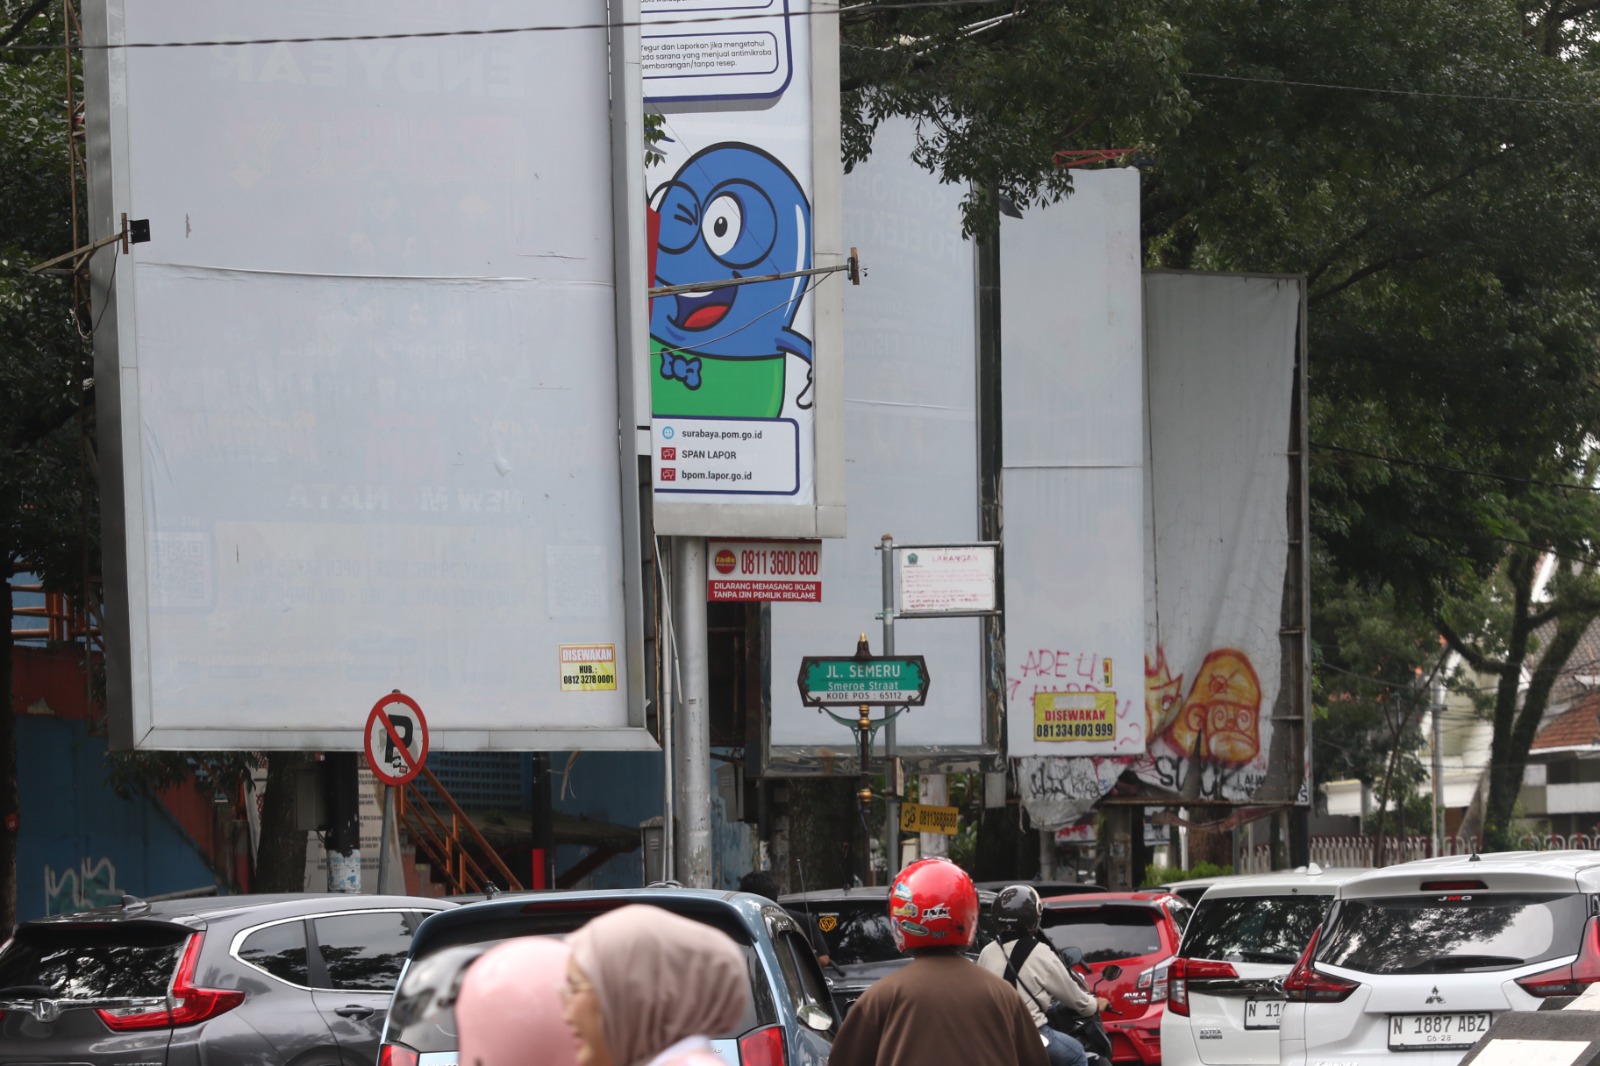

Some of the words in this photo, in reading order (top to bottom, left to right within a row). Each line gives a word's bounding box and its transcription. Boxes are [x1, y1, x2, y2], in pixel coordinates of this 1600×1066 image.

[676, 42, 710, 51] Laporkan
[710, 41, 723, 50] jika
[723, 40, 765, 49] mengetahui
[682, 52, 700, 60] yang
[701, 50, 730, 60] menjual
[730, 49, 772, 57] antimikroba
[715, 60, 737, 68] resep.
[681, 429, 763, 441] surabaya.pom.go.id
[681, 450, 706, 459] SPAN
[707, 451, 737, 460] LAPOR
[681, 470, 753, 481] bpom.lapor.go.id
[741, 550, 767, 575] 0811
[770, 551, 797, 575] 3600
[798, 551, 819, 575] 800
[714, 582, 751, 590] DILARANG
[752, 583, 793, 591] MEMASANG
[713, 591, 737, 599] TANPA
[753, 591, 782, 599] PEMILIK
[782, 592, 816, 600] REKLAME
[562, 648, 613, 661] DISEWAKAN
[1020, 649, 1071, 677] ARE
[826, 665, 844, 679] JL.
[849, 664, 901, 678] SEMERU
[563, 675, 580, 685] 0812
[580, 675, 597, 684] 3278
[597, 674, 614, 684] 0001
[828, 681, 865, 691] Smeroe
[868, 681, 899, 690] Straat
[826, 692, 849, 700] KODE
[852, 692, 870, 700] POS
[879, 691, 902, 700] 65112
[1045, 709, 1106, 721] DISEWAKAN
[1074, 723, 1094, 737] 803
[1095, 723, 1113, 736] 999
[923, 908, 948, 917] INK
[1248, 1003, 1257, 1017] N
[1265, 1003, 1287, 1017] 11
[1393, 1017, 1403, 1035] N
[1414, 1016, 1453, 1034] 1887
[1458, 1015, 1486, 1032] ABZ
